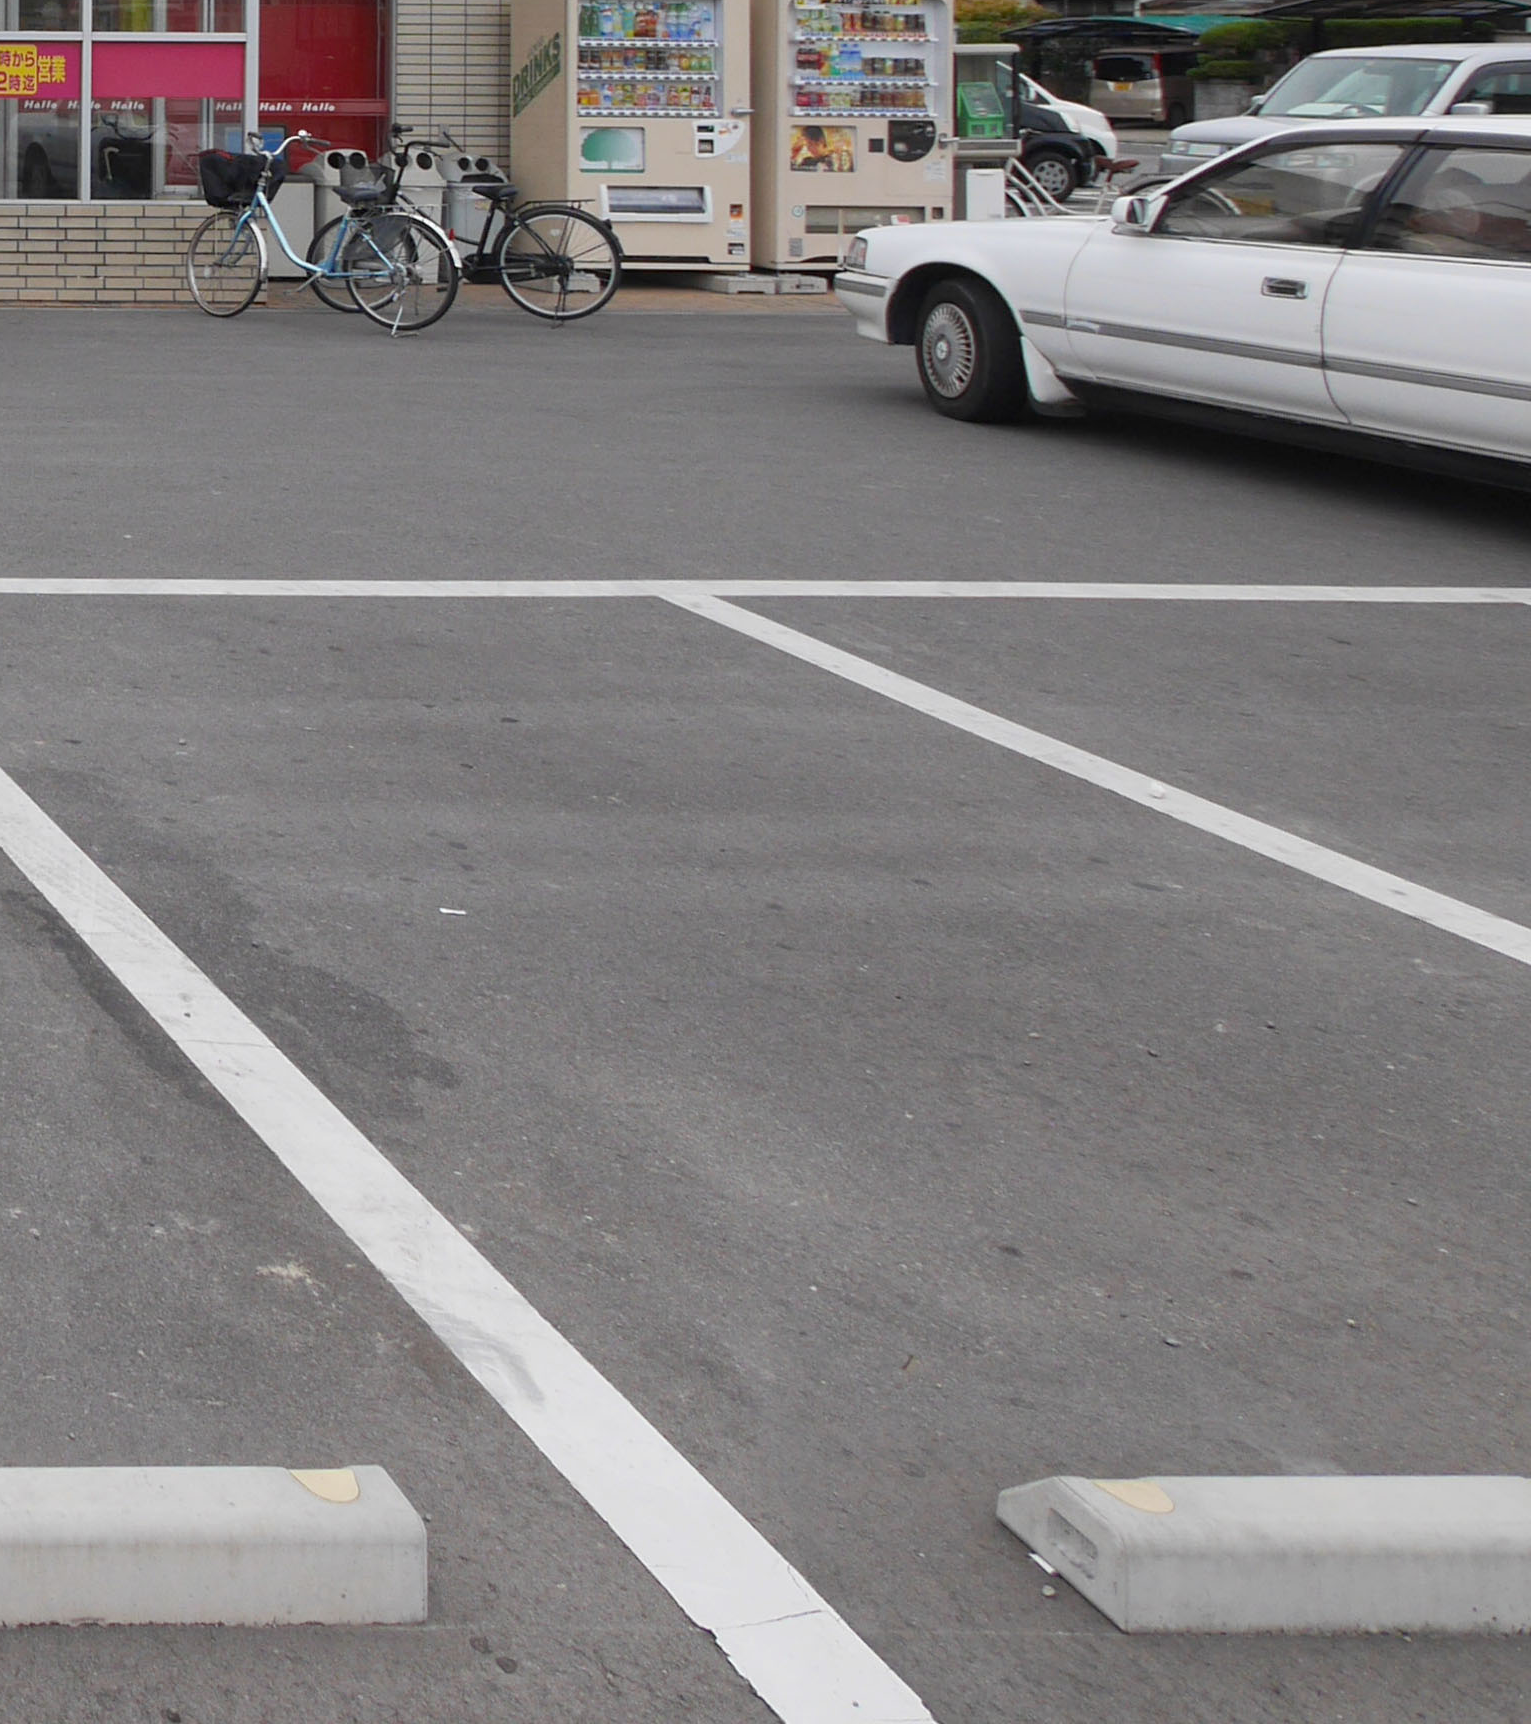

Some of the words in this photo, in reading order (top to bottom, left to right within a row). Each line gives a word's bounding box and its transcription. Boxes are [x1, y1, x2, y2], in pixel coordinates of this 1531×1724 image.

[37, 55, 67, 84] 営業
[513, 31, 560, 97] DRINKS
[23, 99, 58, 109] Hallo
[110, 100, 145, 110] Hallo
[215, 102, 243, 111] Hall
[259, 102, 292, 112] Hallo
[302, 102, 336, 112] Hallo
